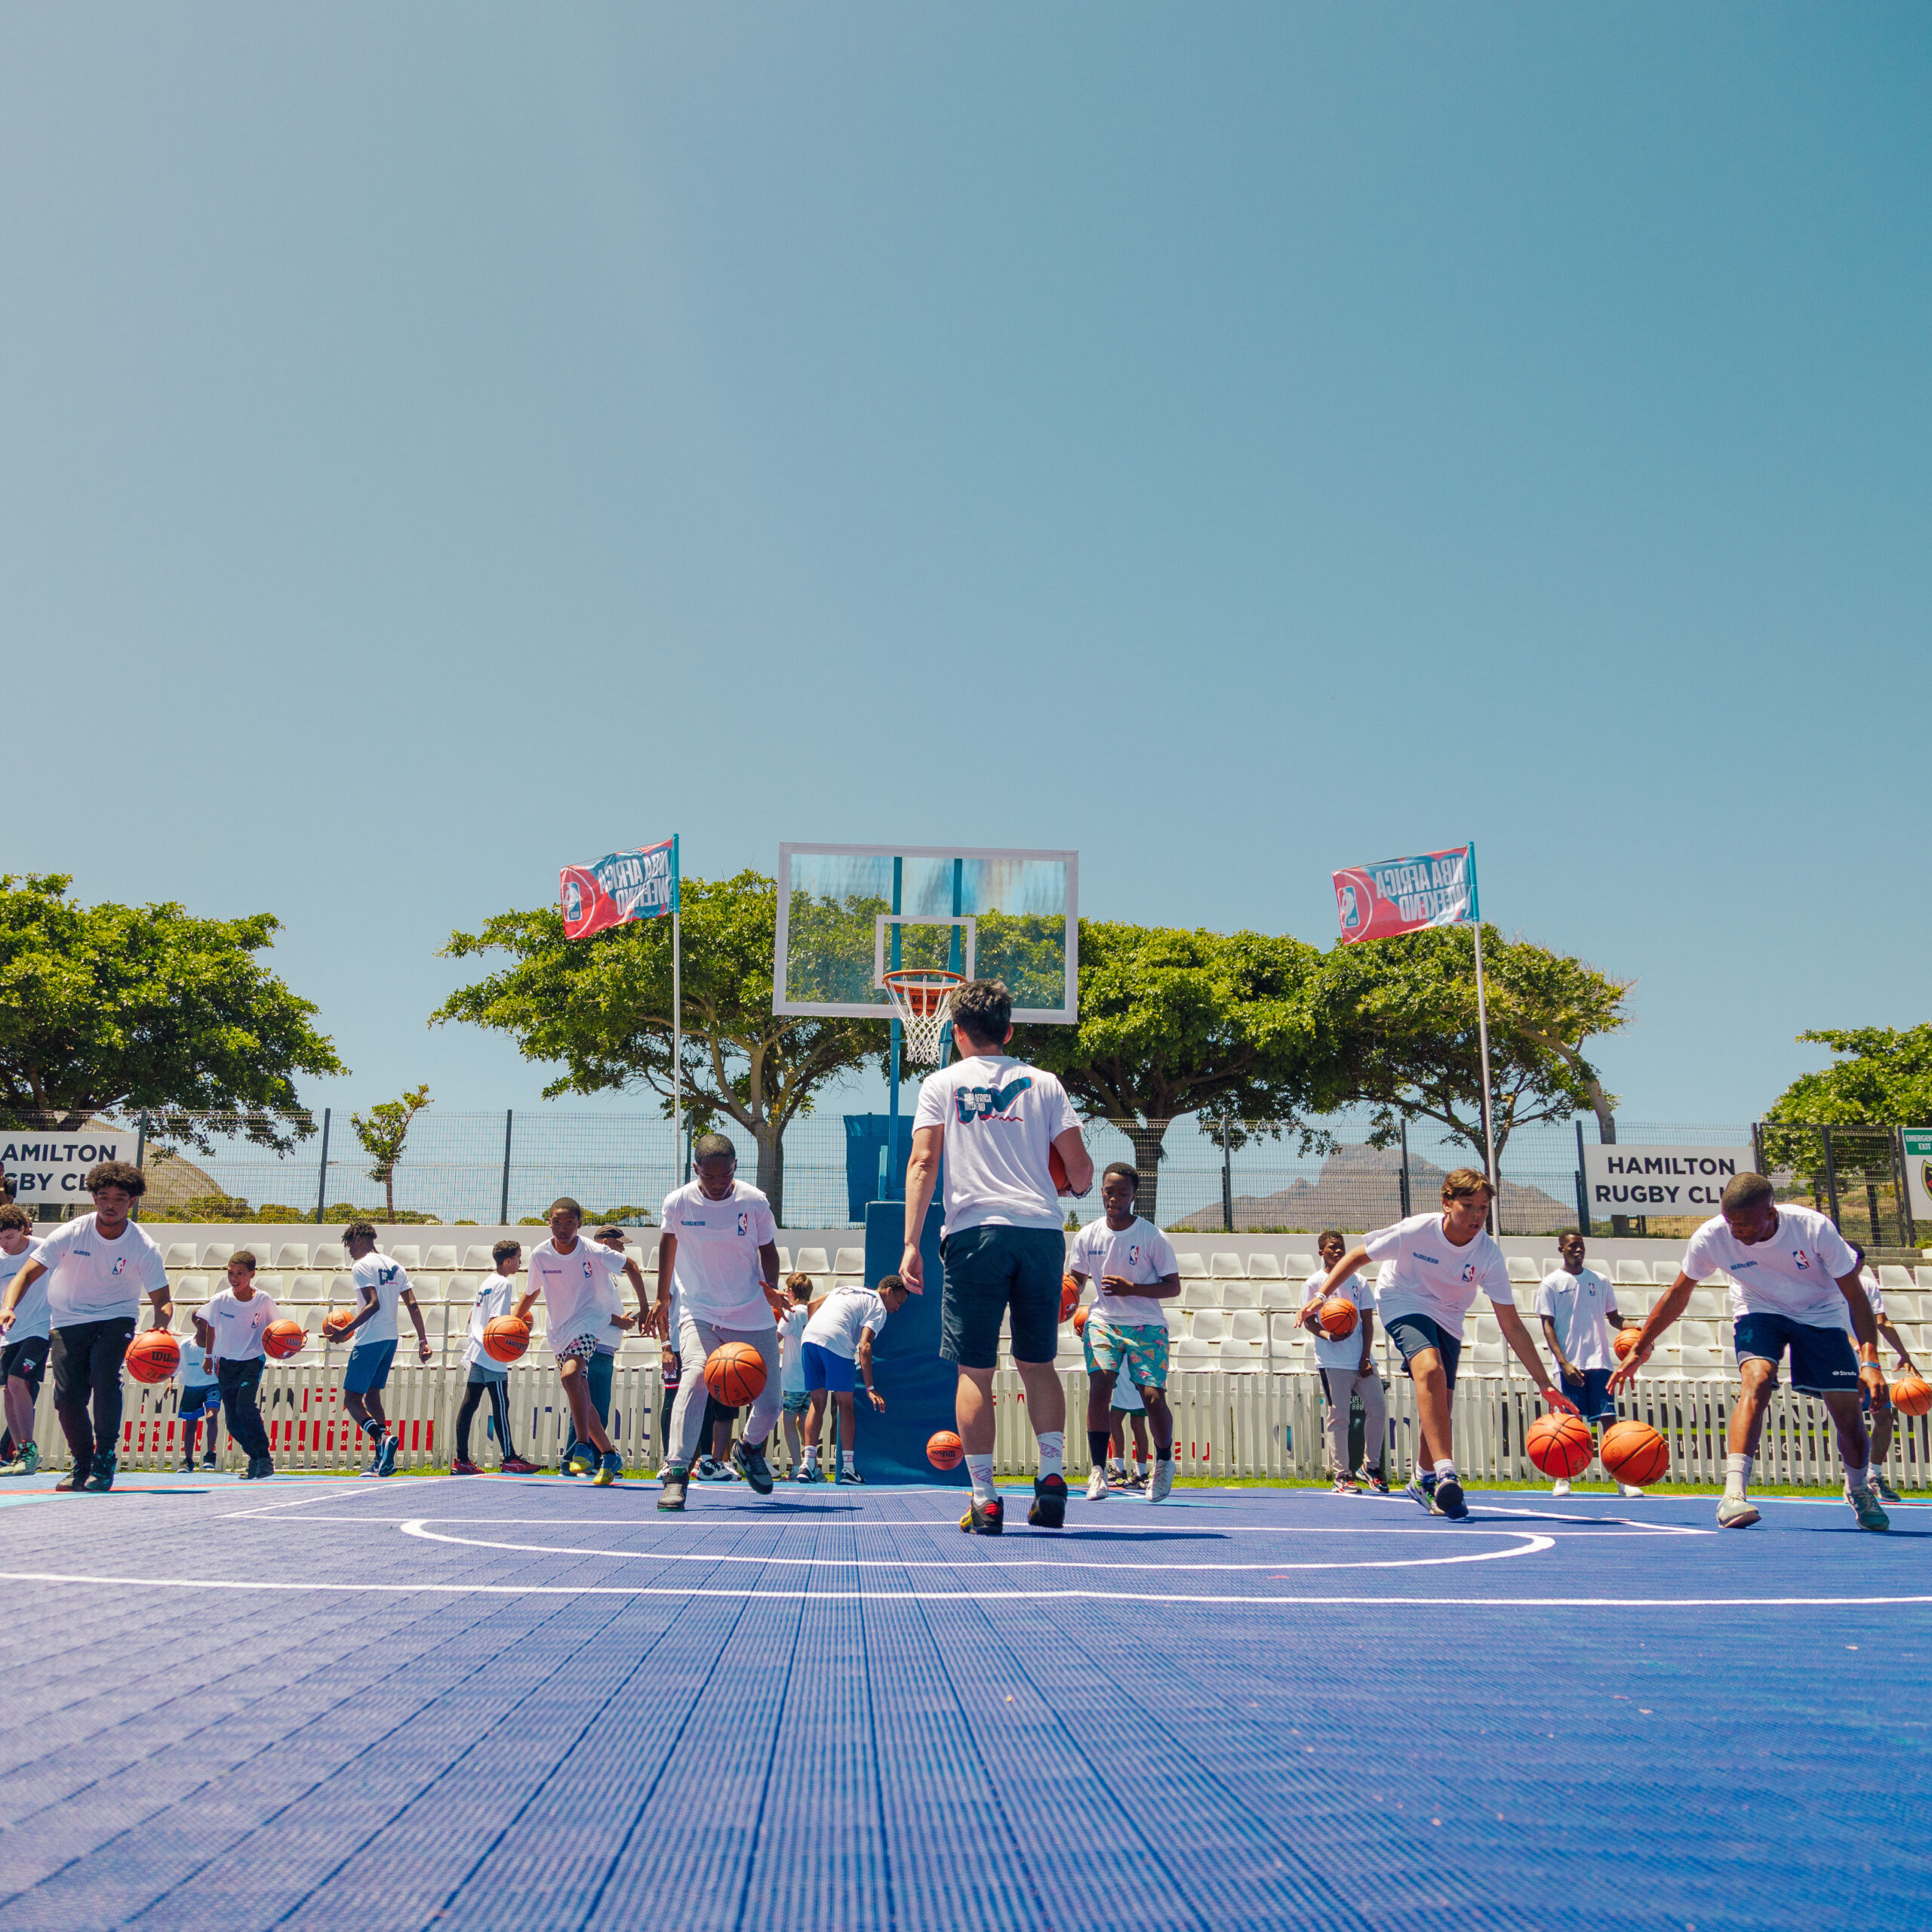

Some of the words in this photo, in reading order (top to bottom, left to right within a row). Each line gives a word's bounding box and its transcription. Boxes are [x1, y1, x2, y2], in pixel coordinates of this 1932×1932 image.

[1607, 1157, 1735, 1176] HAMILTON
[60, 1173, 88, 1191] CL
[1595, 1185, 1680, 1203] RUGBY
[1739, 1327, 1753, 1343] 4
